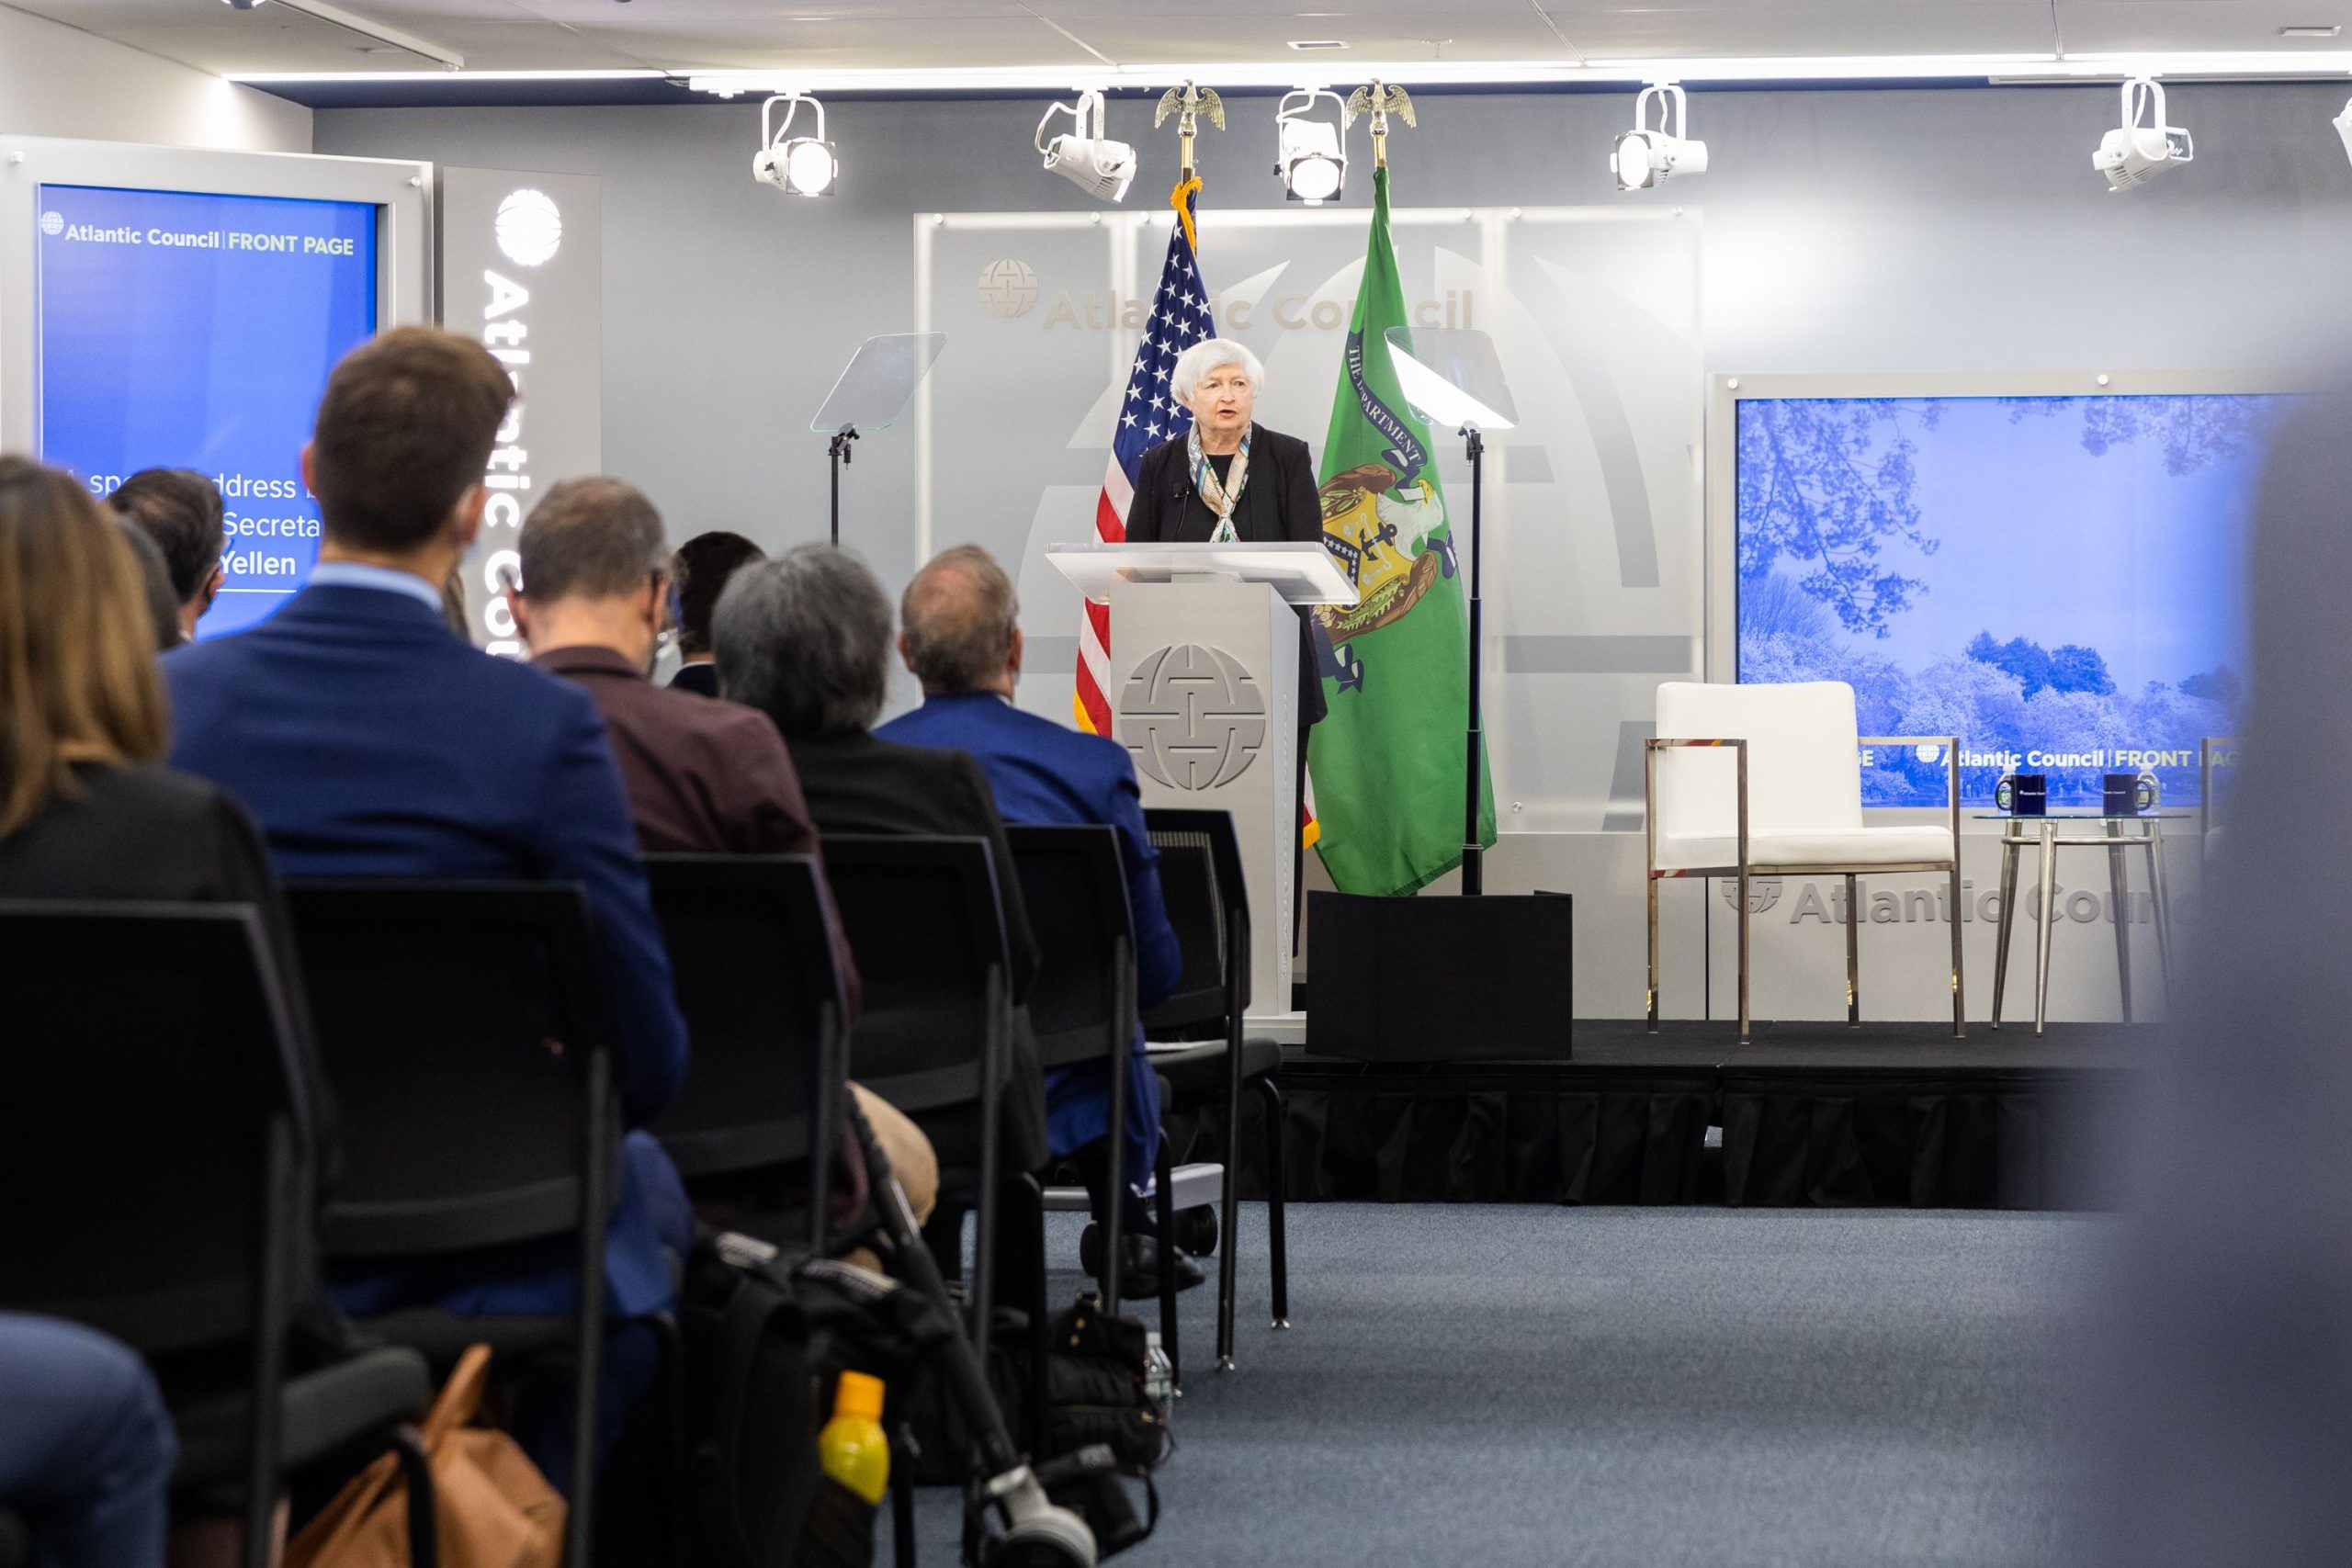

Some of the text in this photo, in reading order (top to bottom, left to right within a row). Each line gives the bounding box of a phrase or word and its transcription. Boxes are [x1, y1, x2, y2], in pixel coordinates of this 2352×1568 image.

[64, 224, 354, 256] Atlantic Council FRONT PAGE
[1043, 288, 1473, 332] Atlaic Cocil
[1349, 344, 1422, 463] THE DPARTMENT
[212, 472, 297, 499] ddress
[222, 511, 320, 537] Secreta
[220, 551, 296, 575] Yellen
[2027, 750, 2104, 767] Council
[2115, 750, 2193, 767] FRONT
